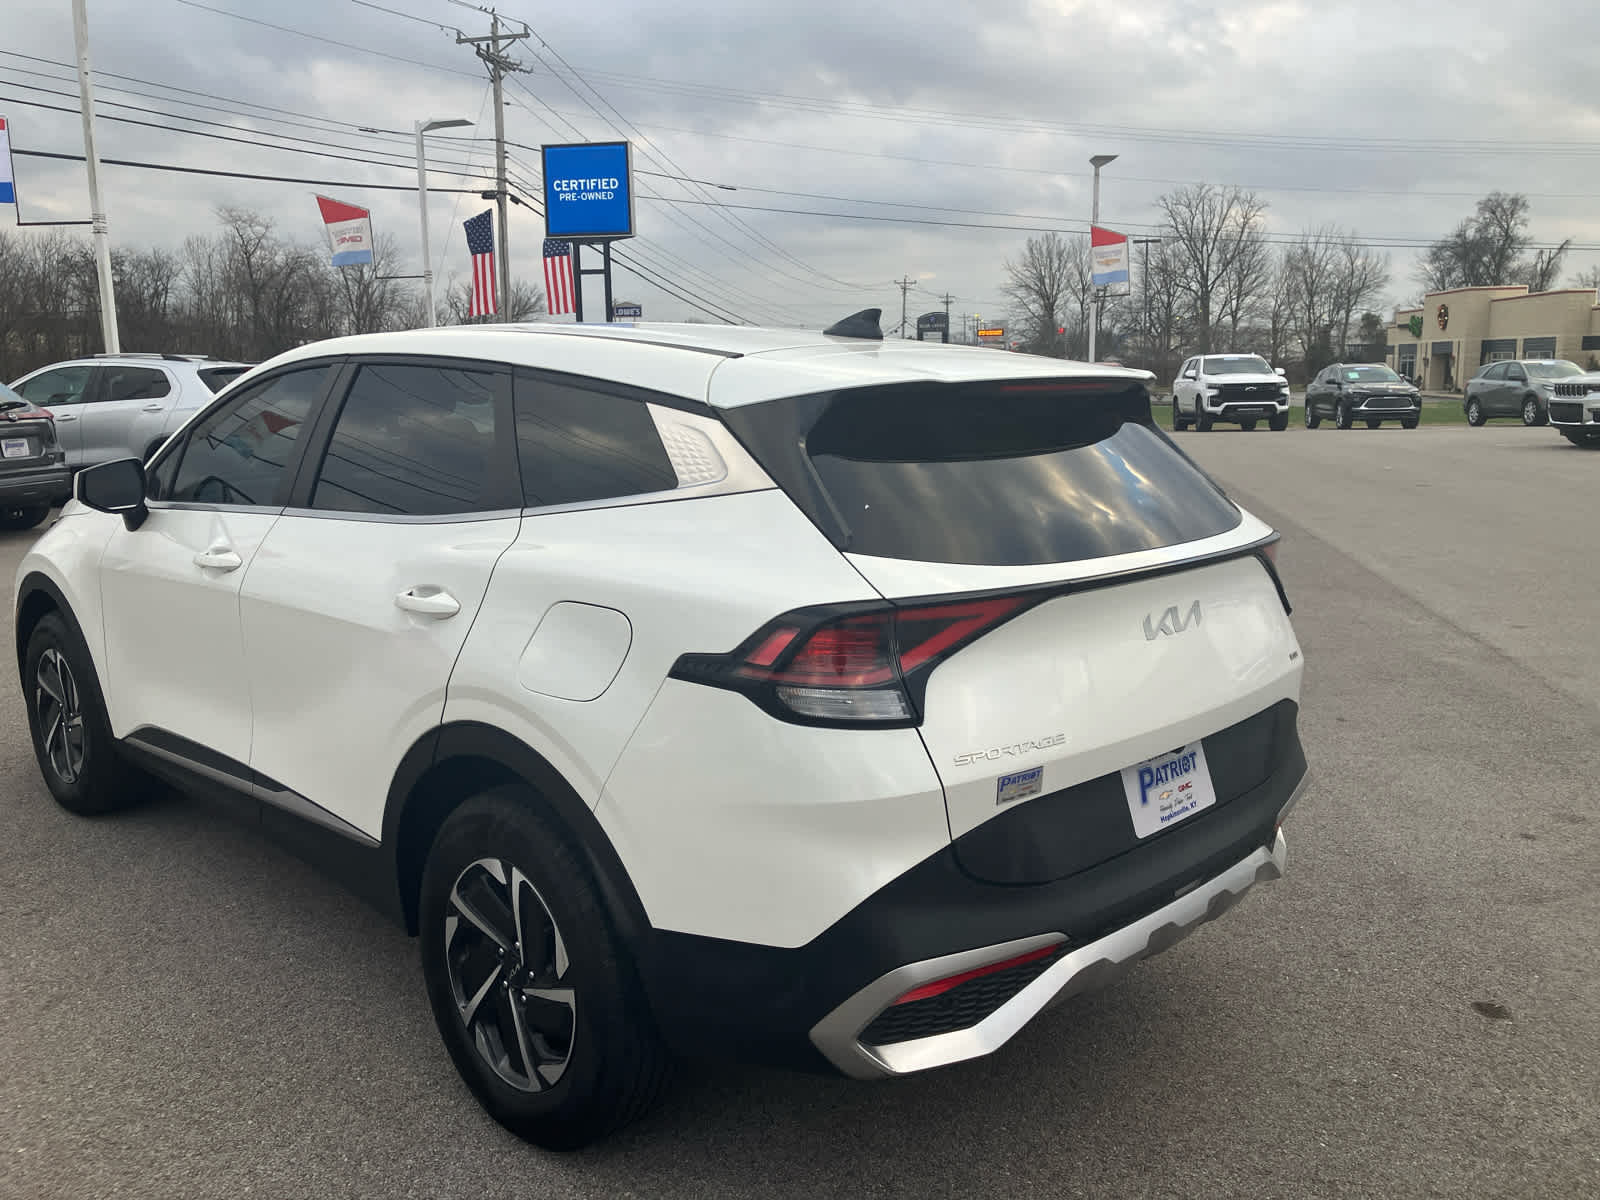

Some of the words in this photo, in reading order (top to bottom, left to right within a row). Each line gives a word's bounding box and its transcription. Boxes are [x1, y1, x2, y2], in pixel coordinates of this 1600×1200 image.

[553, 178, 619, 192] CERTIFIED
[559, 191, 614, 201] PRE-OWNED
[1143, 599, 1202, 641] KIA
[953, 733, 1066, 767] SPORTAGE
[1138, 751, 1197, 806] PATRIOT
